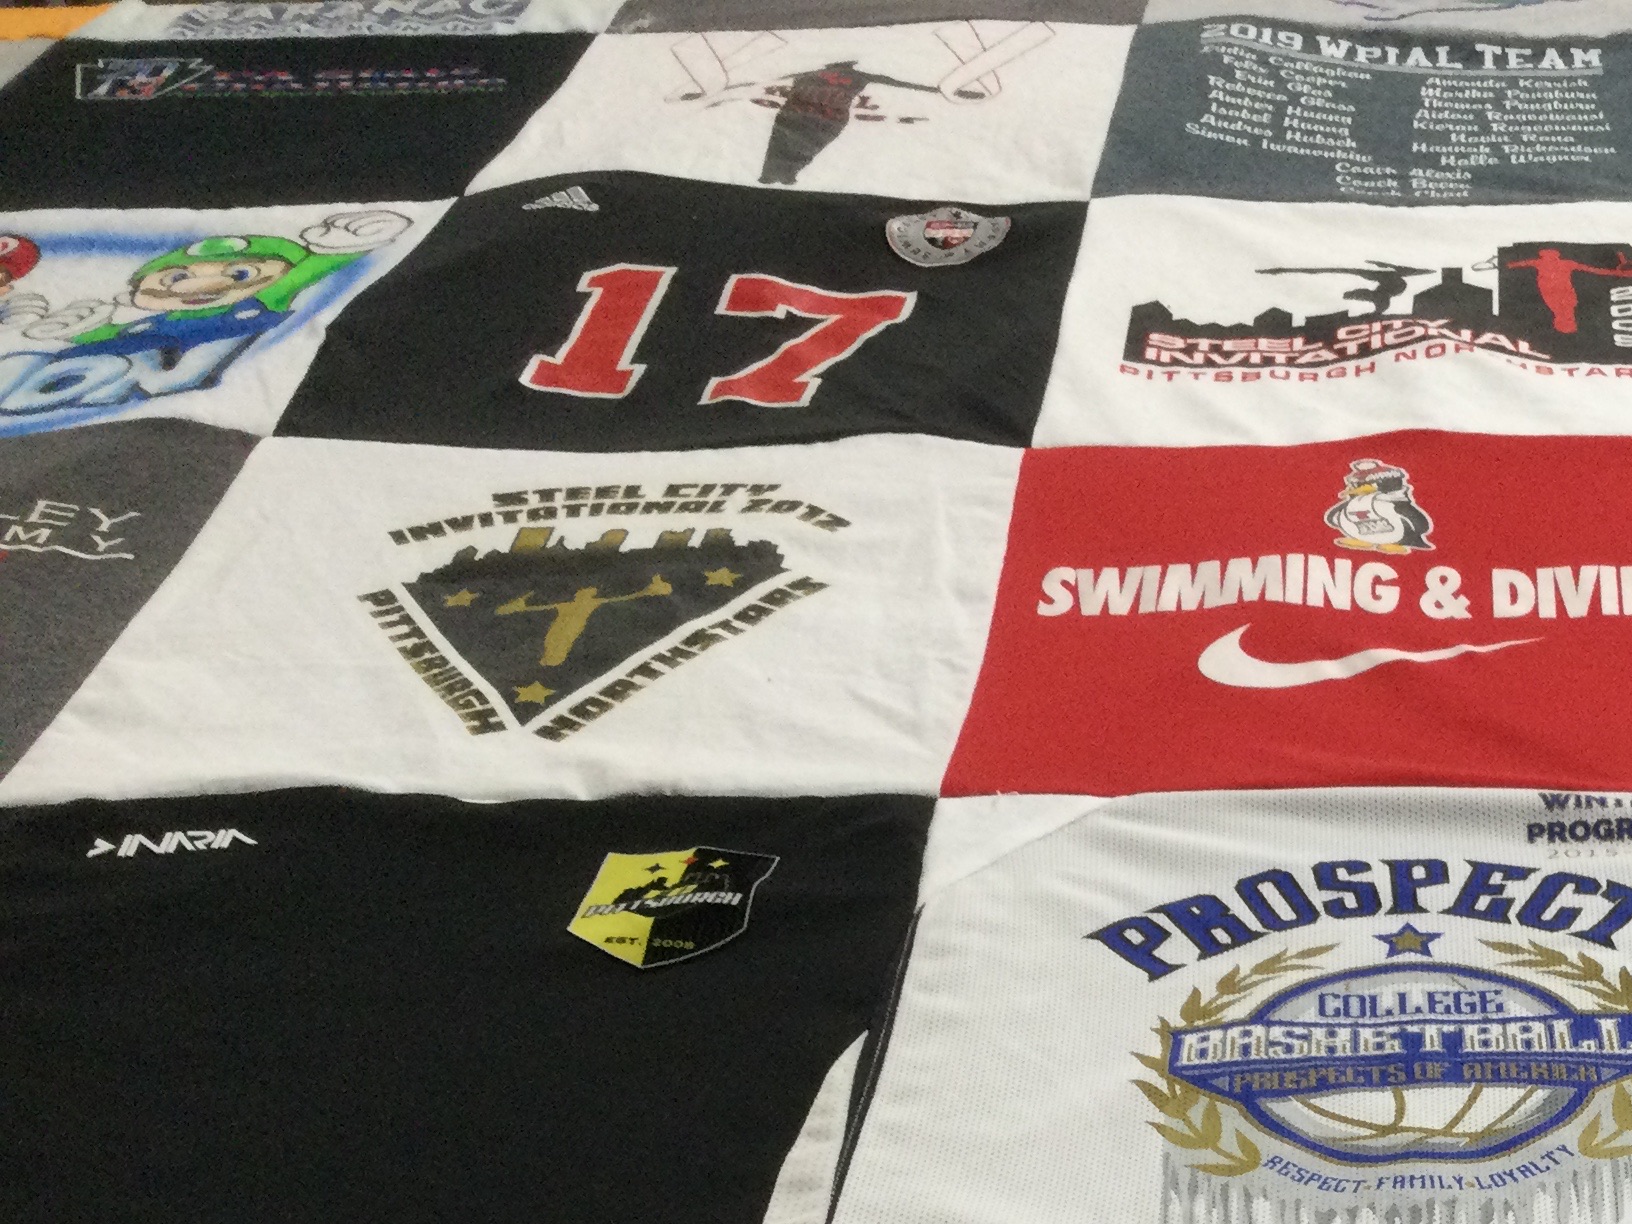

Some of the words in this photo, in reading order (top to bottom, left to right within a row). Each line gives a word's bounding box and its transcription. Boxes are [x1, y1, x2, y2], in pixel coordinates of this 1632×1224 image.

[1201, 23, 1303, 50] 2019
[1316, 35, 1462, 69] WPIAL
[1475, 44, 1602, 69] TEAM
[519, 262, 918, 408] 17
[1142, 326, 1552, 367] INVITATIONAL
[1146, 331, 1322, 353] STEEL
[1336, 317, 1456, 342] CITY
[1117, 362, 1377, 384] PITTSBURGH
[0, 499, 141, 532] EY
[491, 483, 643, 508] STEEL
[664, 482, 782, 498] CITY
[387, 498, 728, 546] INVITATIONAL
[1036, 553, 1400, 617] SWIMMING
[1419, 564, 1473, 620] &
[356, 587, 509, 737] PITTSBURGH
[532, 576, 830, 743] NORTHSTARS
[1318, 988, 1506, 1020] COLLEGE
[1227, 1063, 1407, 1095] PROSPECTS
[1413, 1061, 1451, 1084] OF
[1462, 1060, 1605, 1084] AMERICA
[1260, 1155, 1366, 1196] RESPECT
[1375, 1173, 1466, 1192] FAMILY
[1474, 1143, 1577, 1192] LOYALTY
